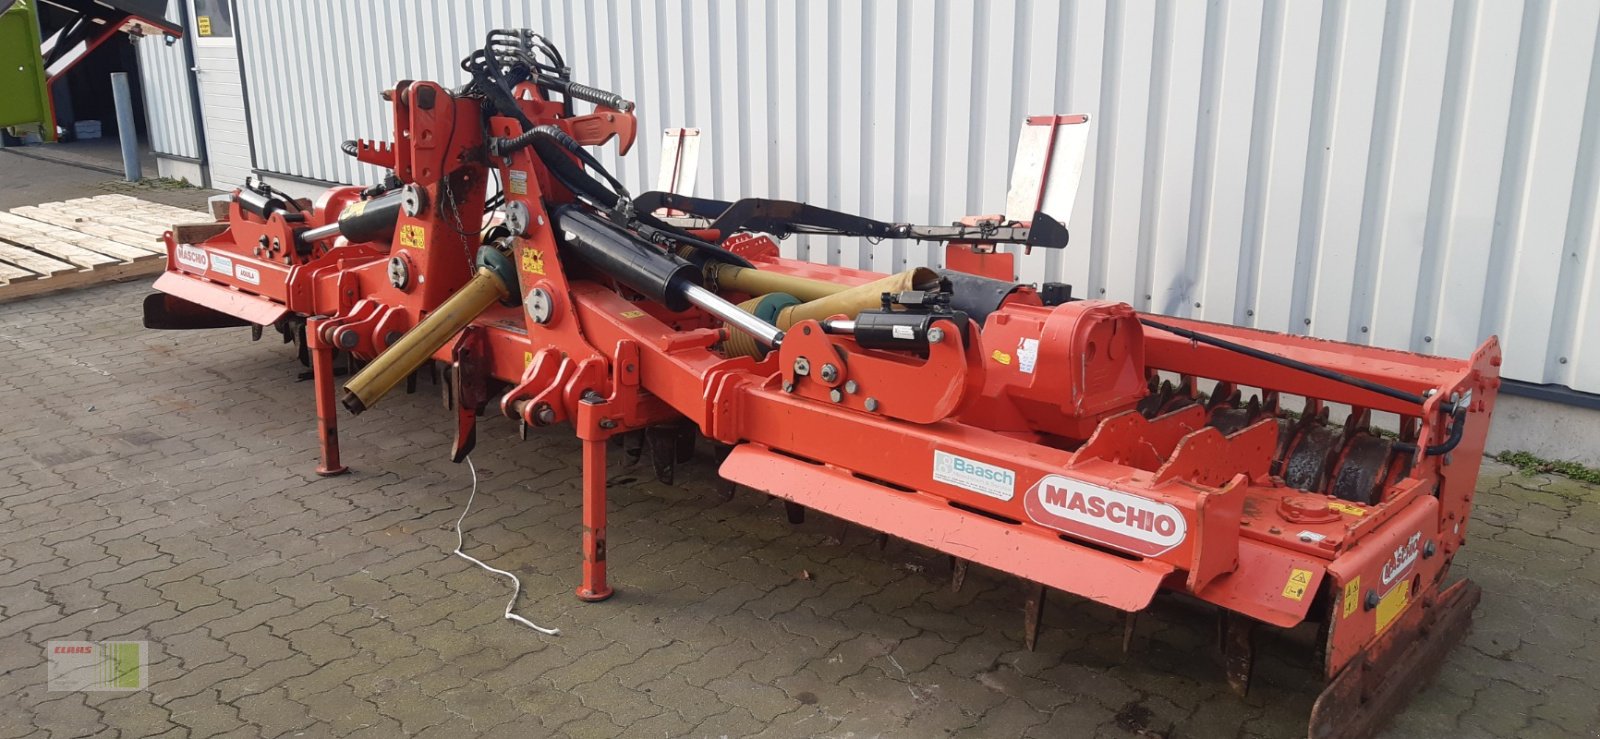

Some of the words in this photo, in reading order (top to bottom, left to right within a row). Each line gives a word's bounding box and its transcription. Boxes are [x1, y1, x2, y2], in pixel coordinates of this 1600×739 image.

[178, 246, 206, 265] MASCHIO
[953, 457, 1013, 486] Baasch
[1045, 483, 1177, 537] MASCHIO
